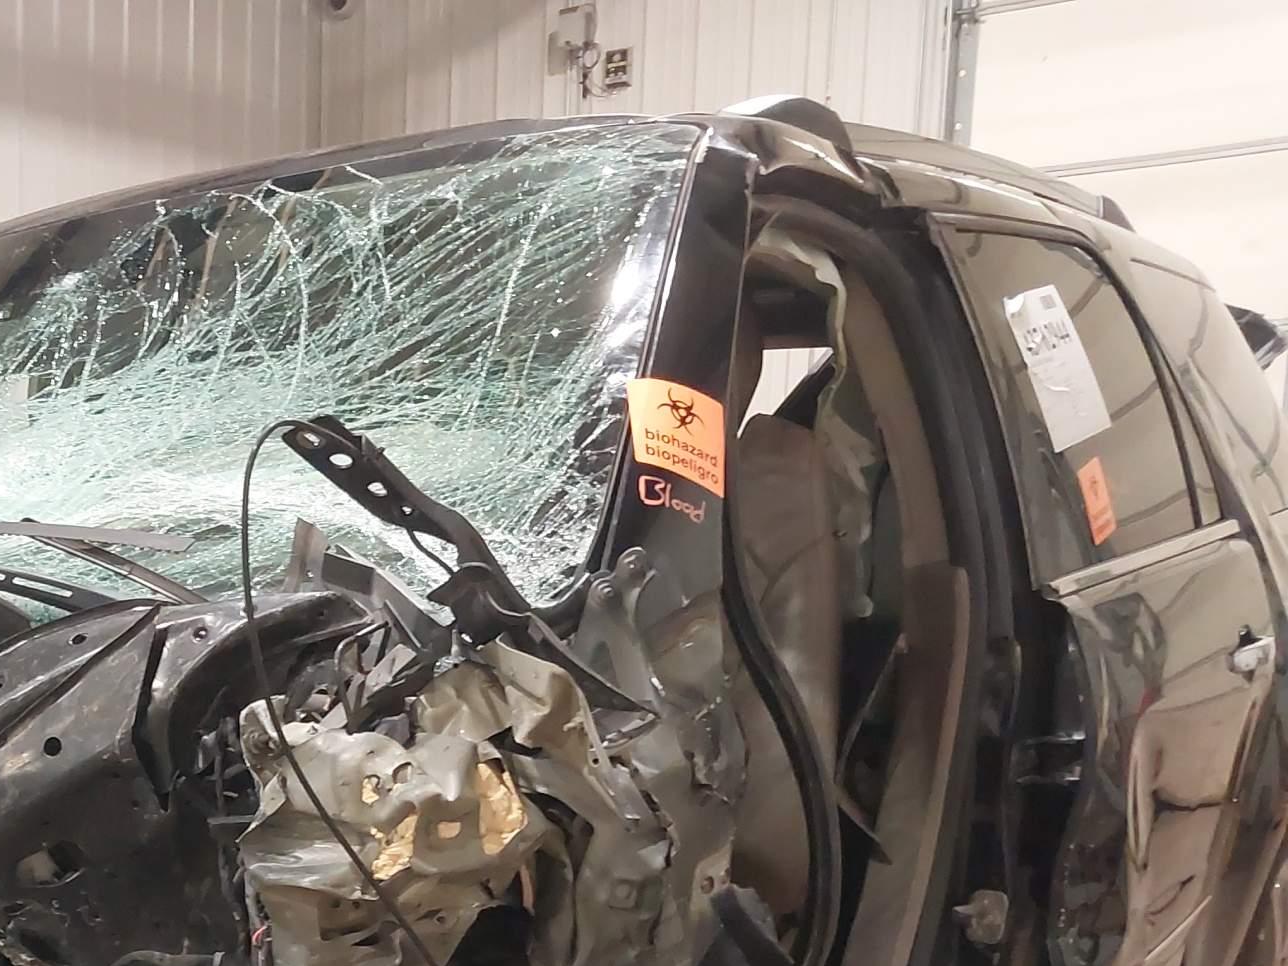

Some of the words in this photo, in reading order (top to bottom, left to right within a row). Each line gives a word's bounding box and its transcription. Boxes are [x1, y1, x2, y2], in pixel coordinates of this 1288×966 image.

[645, 428, 718, 467] biohazard
[645, 444, 719, 485] biopeligro
[638, 475, 706, 525] Blood
